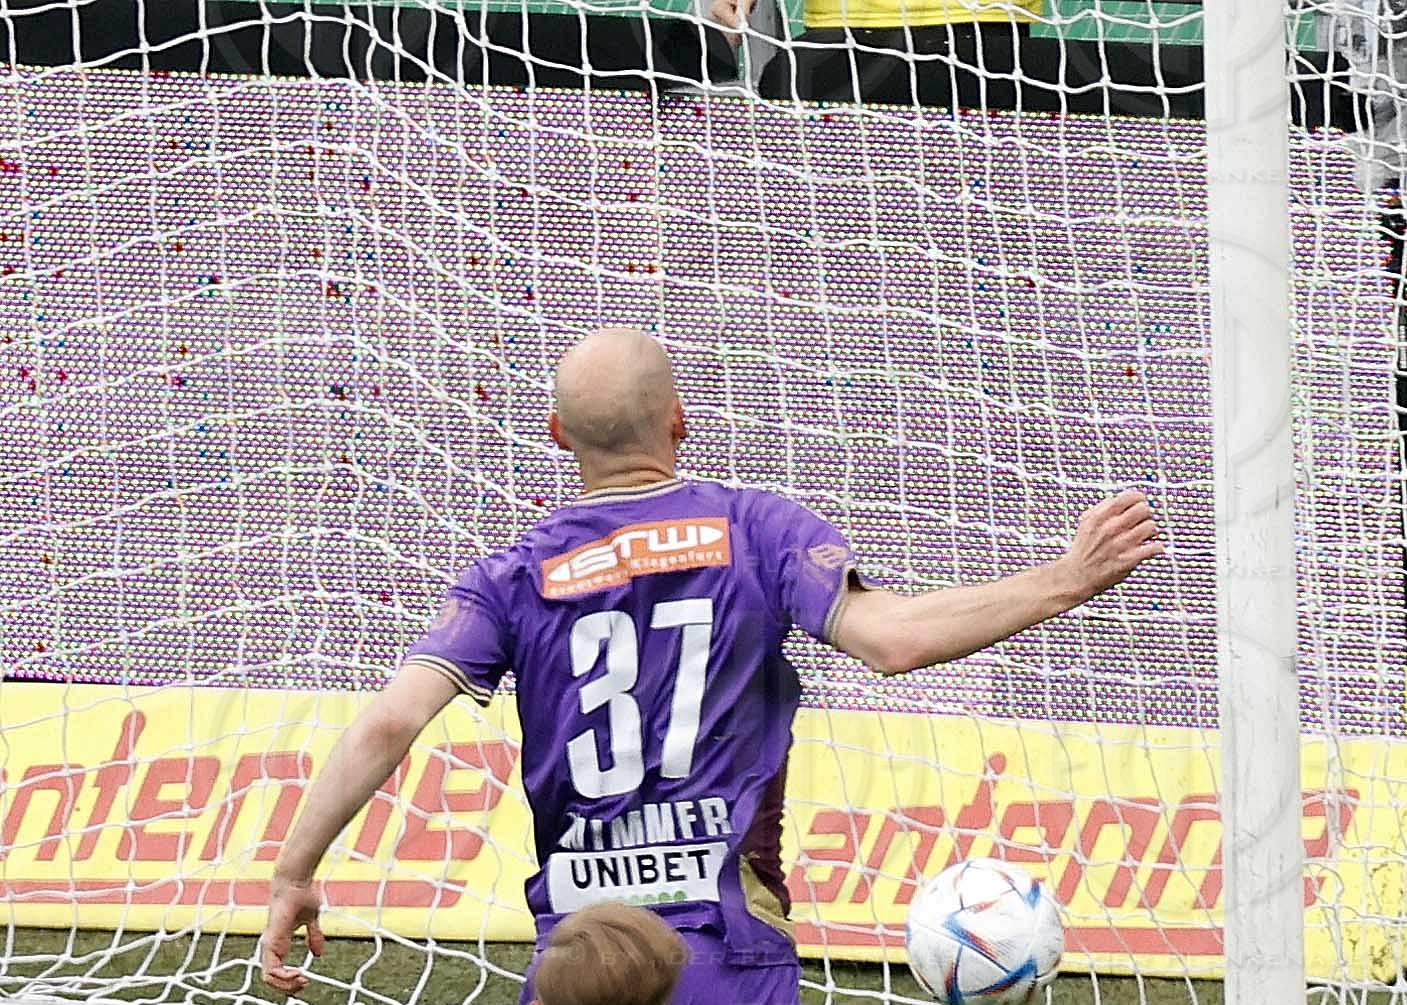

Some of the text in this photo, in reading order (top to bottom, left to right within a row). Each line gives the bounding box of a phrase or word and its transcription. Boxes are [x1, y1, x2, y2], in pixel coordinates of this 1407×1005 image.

[569, 525, 697, 579] STW
[566, 598, 714, 800] 37
[0, 710, 519, 862] ntene
[570, 849, 711, 890] UNIBET
